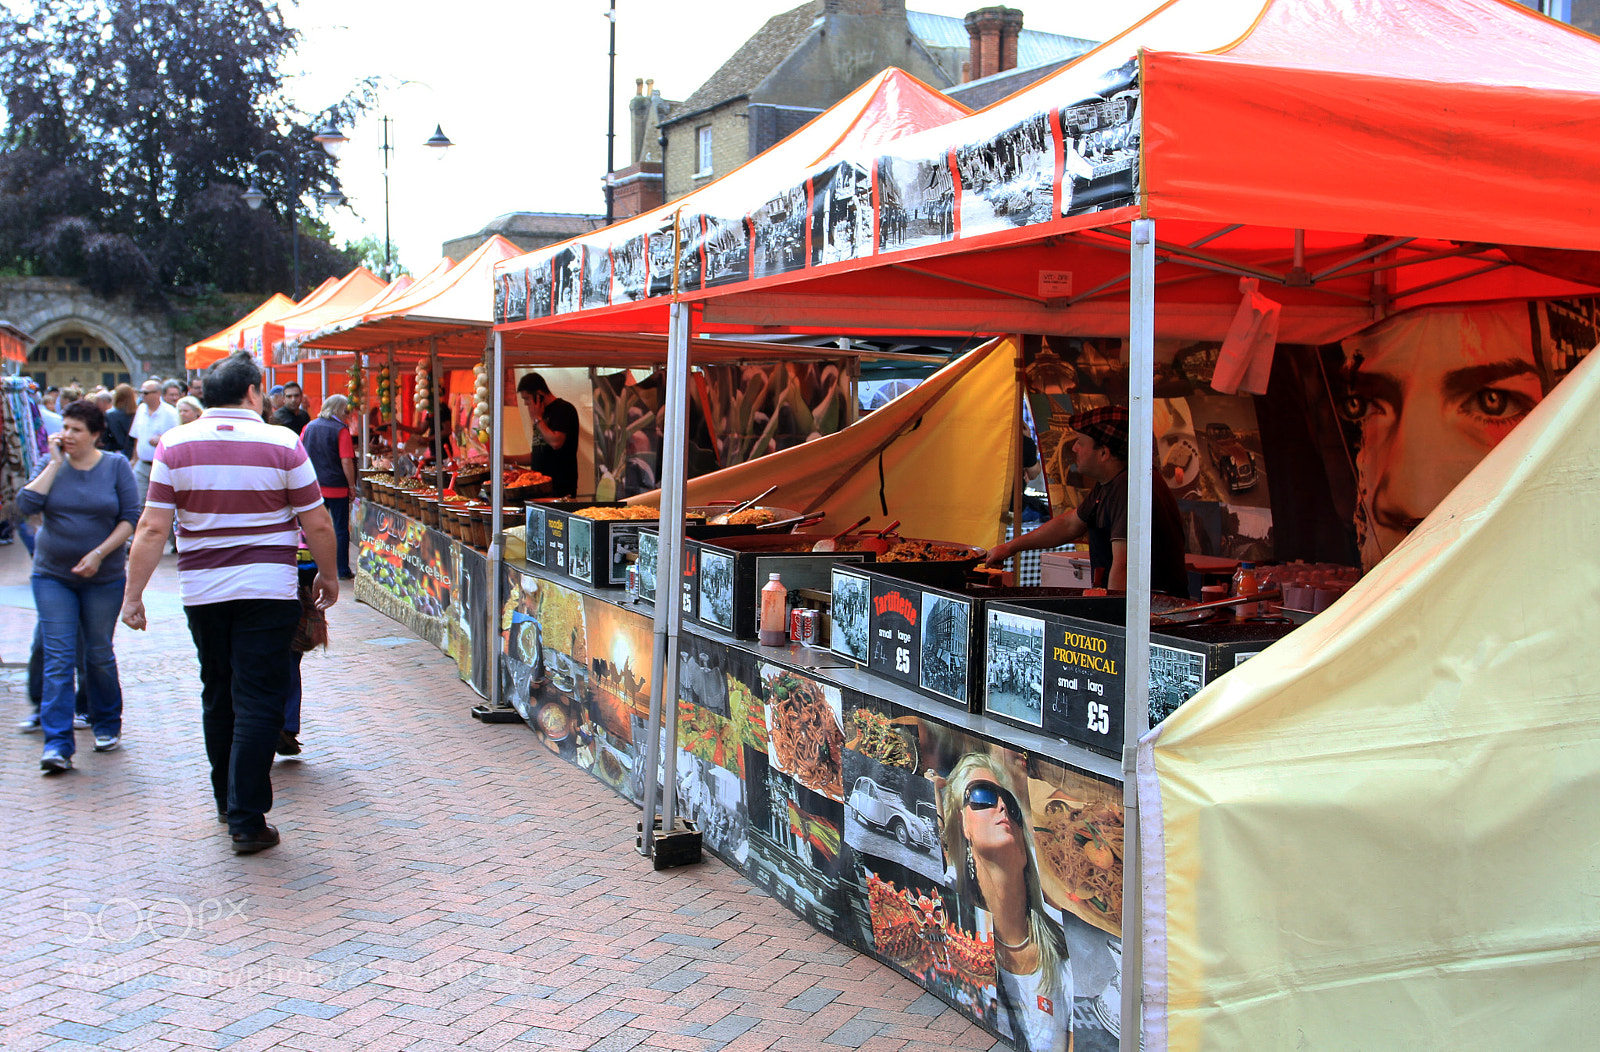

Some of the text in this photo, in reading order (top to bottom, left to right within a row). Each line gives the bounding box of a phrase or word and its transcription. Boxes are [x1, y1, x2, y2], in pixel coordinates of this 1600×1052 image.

[548, 519, 564, 530] noodle
[873, 590, 917, 626] Tartiflette
[878, 628, 912, 644] small large
[1064, 631, 1107, 654] POTATO
[895, 646, 911, 674] £5
[1053, 646, 1118, 675] PROVENCAL
[1057, 676, 1104, 697] small larg
[1087, 700, 1110, 735] £5
